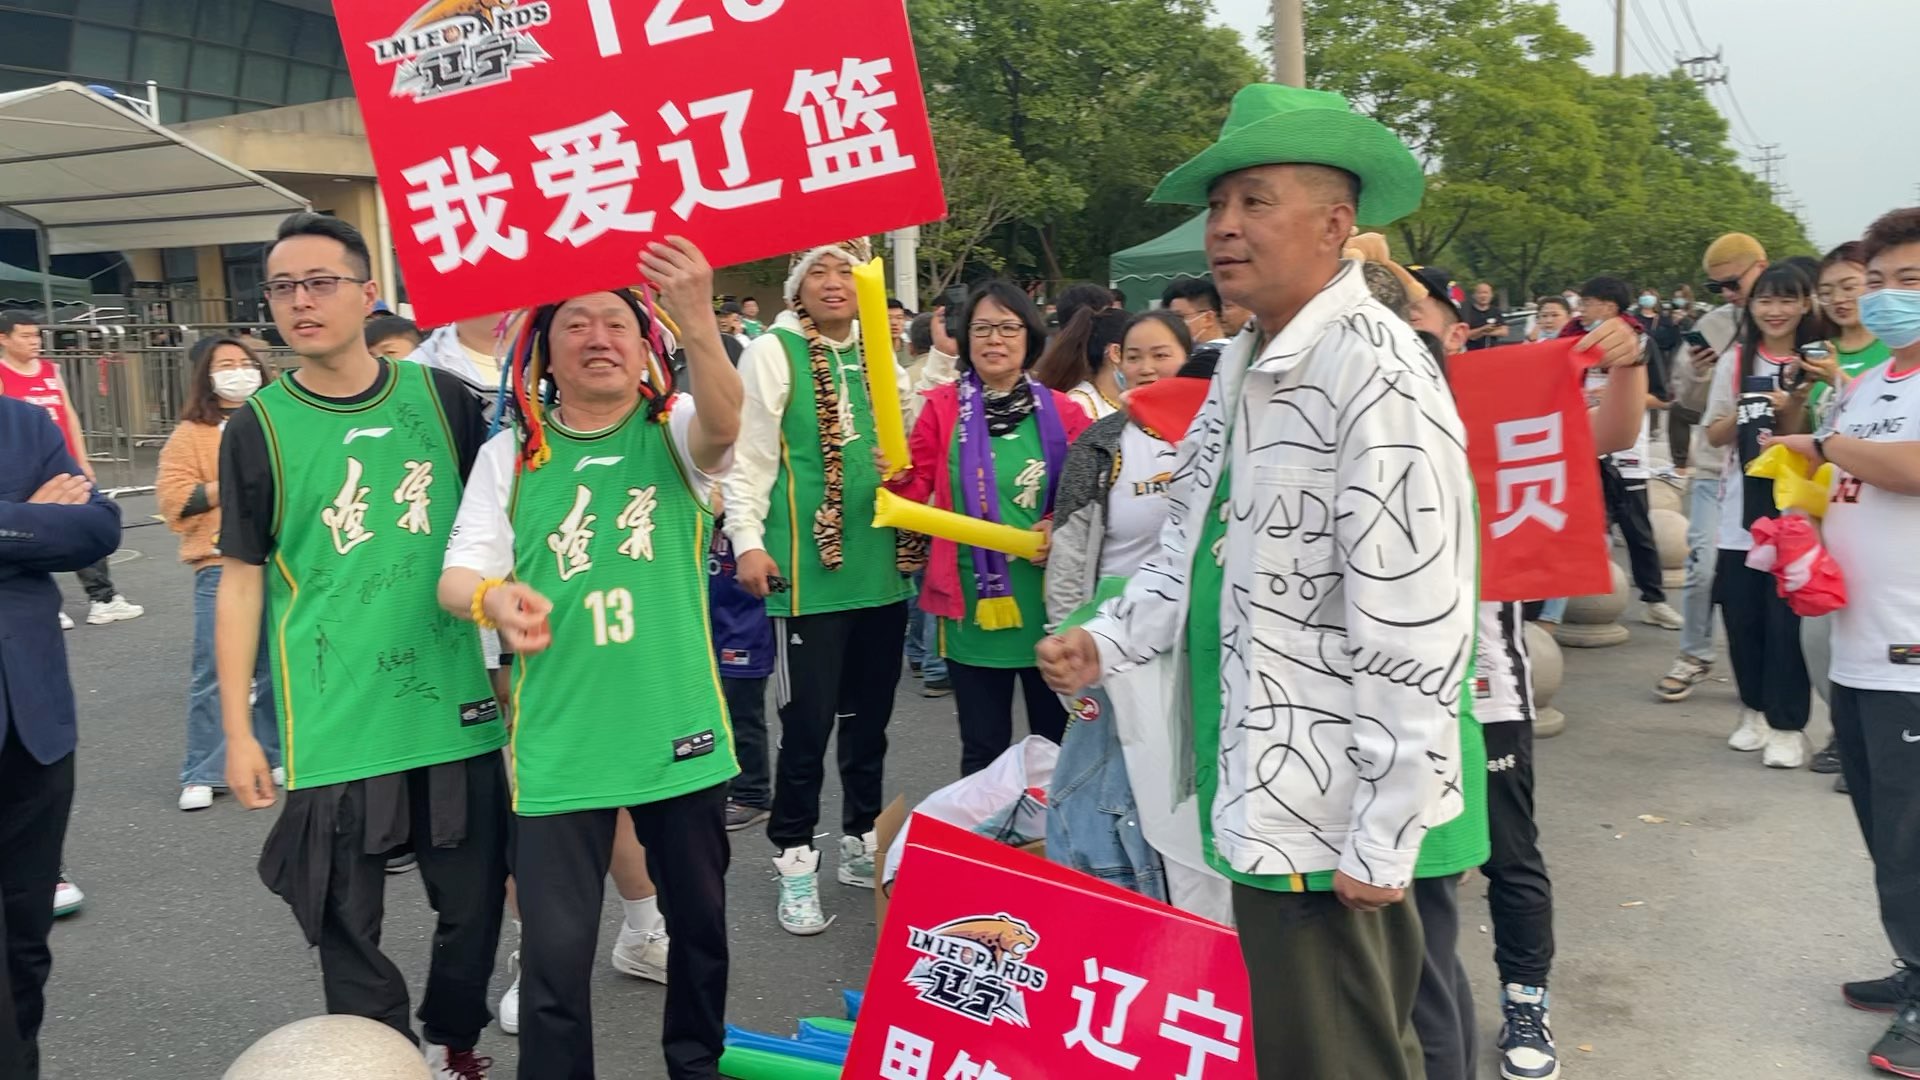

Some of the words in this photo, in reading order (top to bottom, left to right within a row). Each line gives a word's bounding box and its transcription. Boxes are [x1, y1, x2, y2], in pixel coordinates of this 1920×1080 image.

[377, 38, 407, 60] LN
[412, 3, 549, 52] LEOPARDS
[401, 57, 916, 273] 我爱辽篮
[1131, 481, 1170, 497] LIA
[1489, 411, 1568, 540] 员
[583, 587, 636, 647] 13
[937, 938, 1045, 989] LEOPARDS
[1062, 957, 1244, 1080] 辽宁
